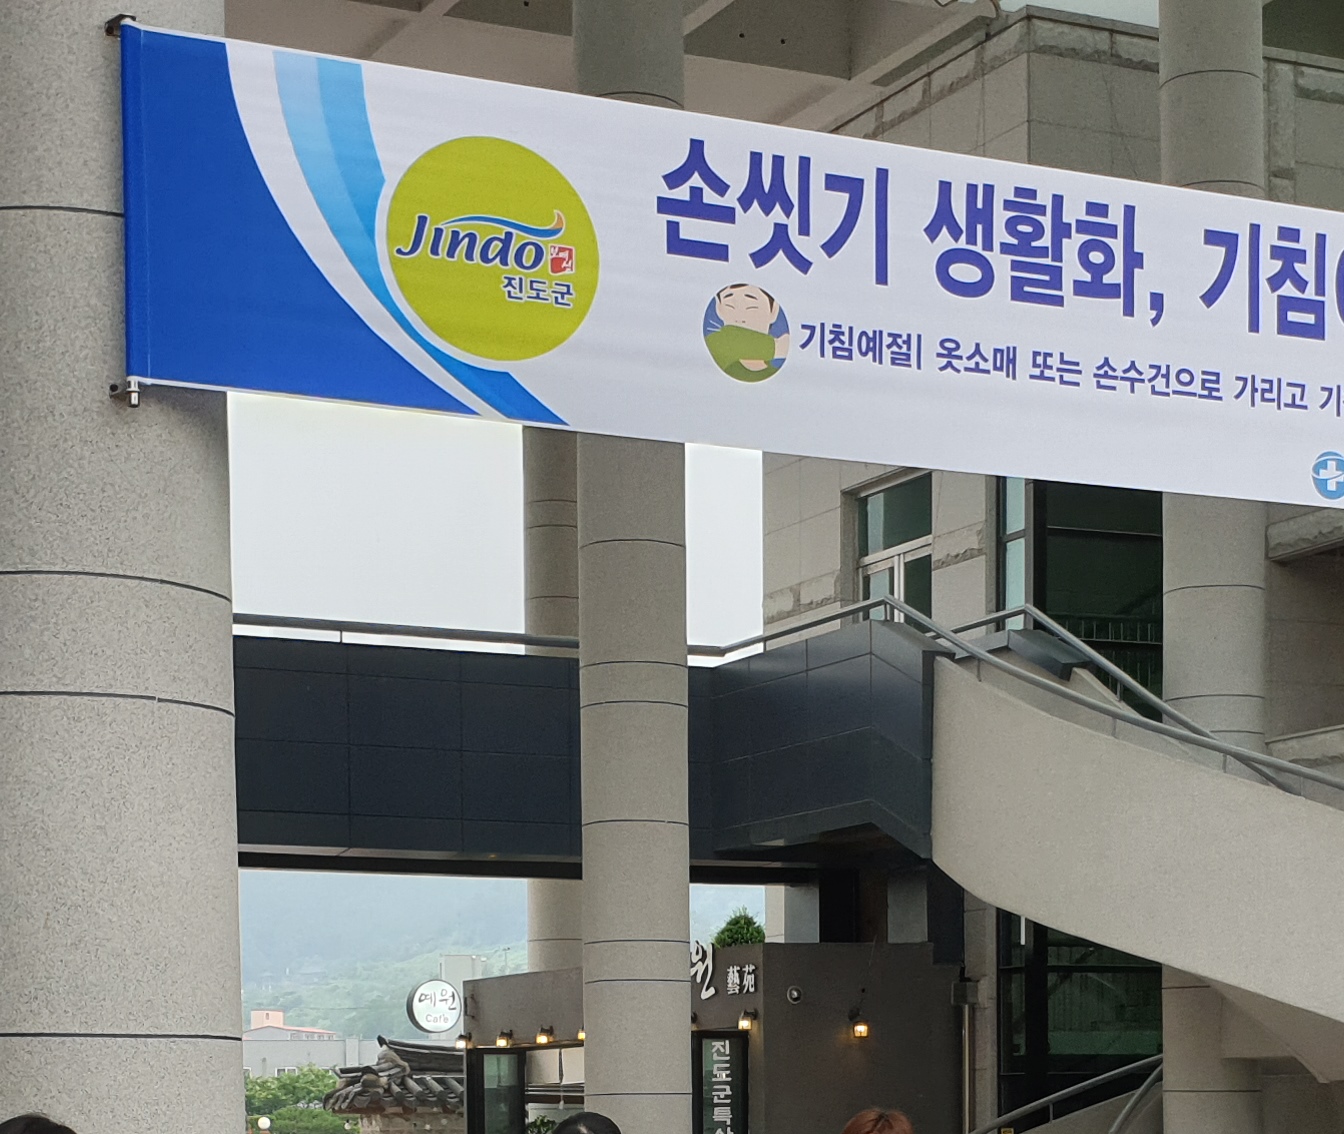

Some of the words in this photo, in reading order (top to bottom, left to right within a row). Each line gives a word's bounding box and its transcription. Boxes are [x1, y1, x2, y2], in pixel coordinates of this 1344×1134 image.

[395, 214, 545, 271] Jindo
[655, 137, 891, 286] 손씻기
[923, 178, 1166, 327] 생활화,
[502, 275, 574, 307] 진도군
[934, 336, 1018, 382] 옷소매
[1027, 349, 1084, 388] 또는
[1091, 355, 1224, 402] 손수건으로
[1233, 373, 1310, 412] 가리고
